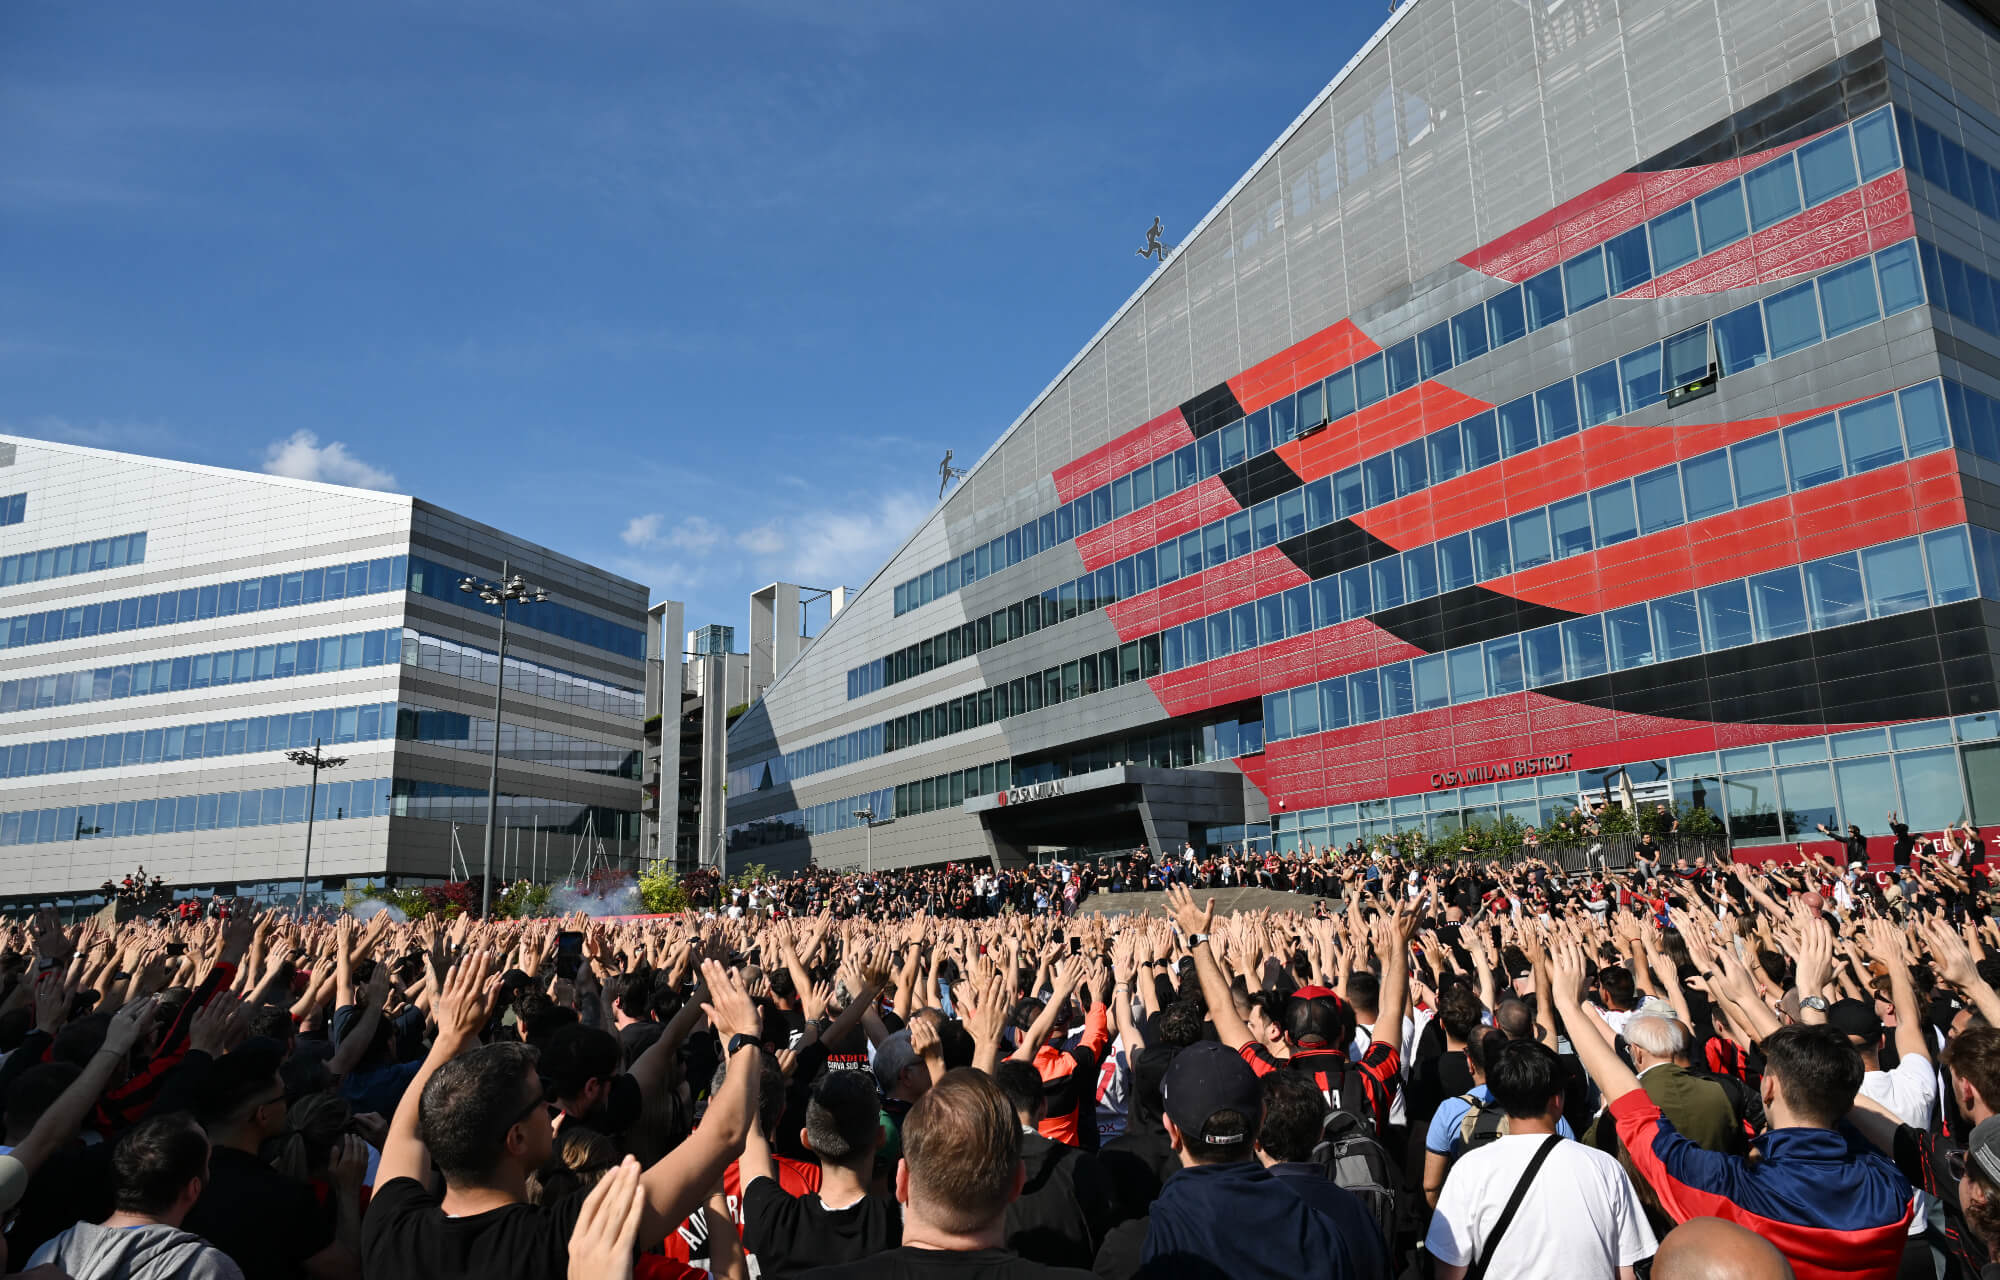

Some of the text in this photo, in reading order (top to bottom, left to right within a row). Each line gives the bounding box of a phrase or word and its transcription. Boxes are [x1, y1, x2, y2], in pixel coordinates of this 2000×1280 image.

[1430, 753, 1573, 788] CASA MILAN BISTROT
[1009, 780, 1065, 804] CASA MILAN
[846, 1061, 859, 1070] SUD
